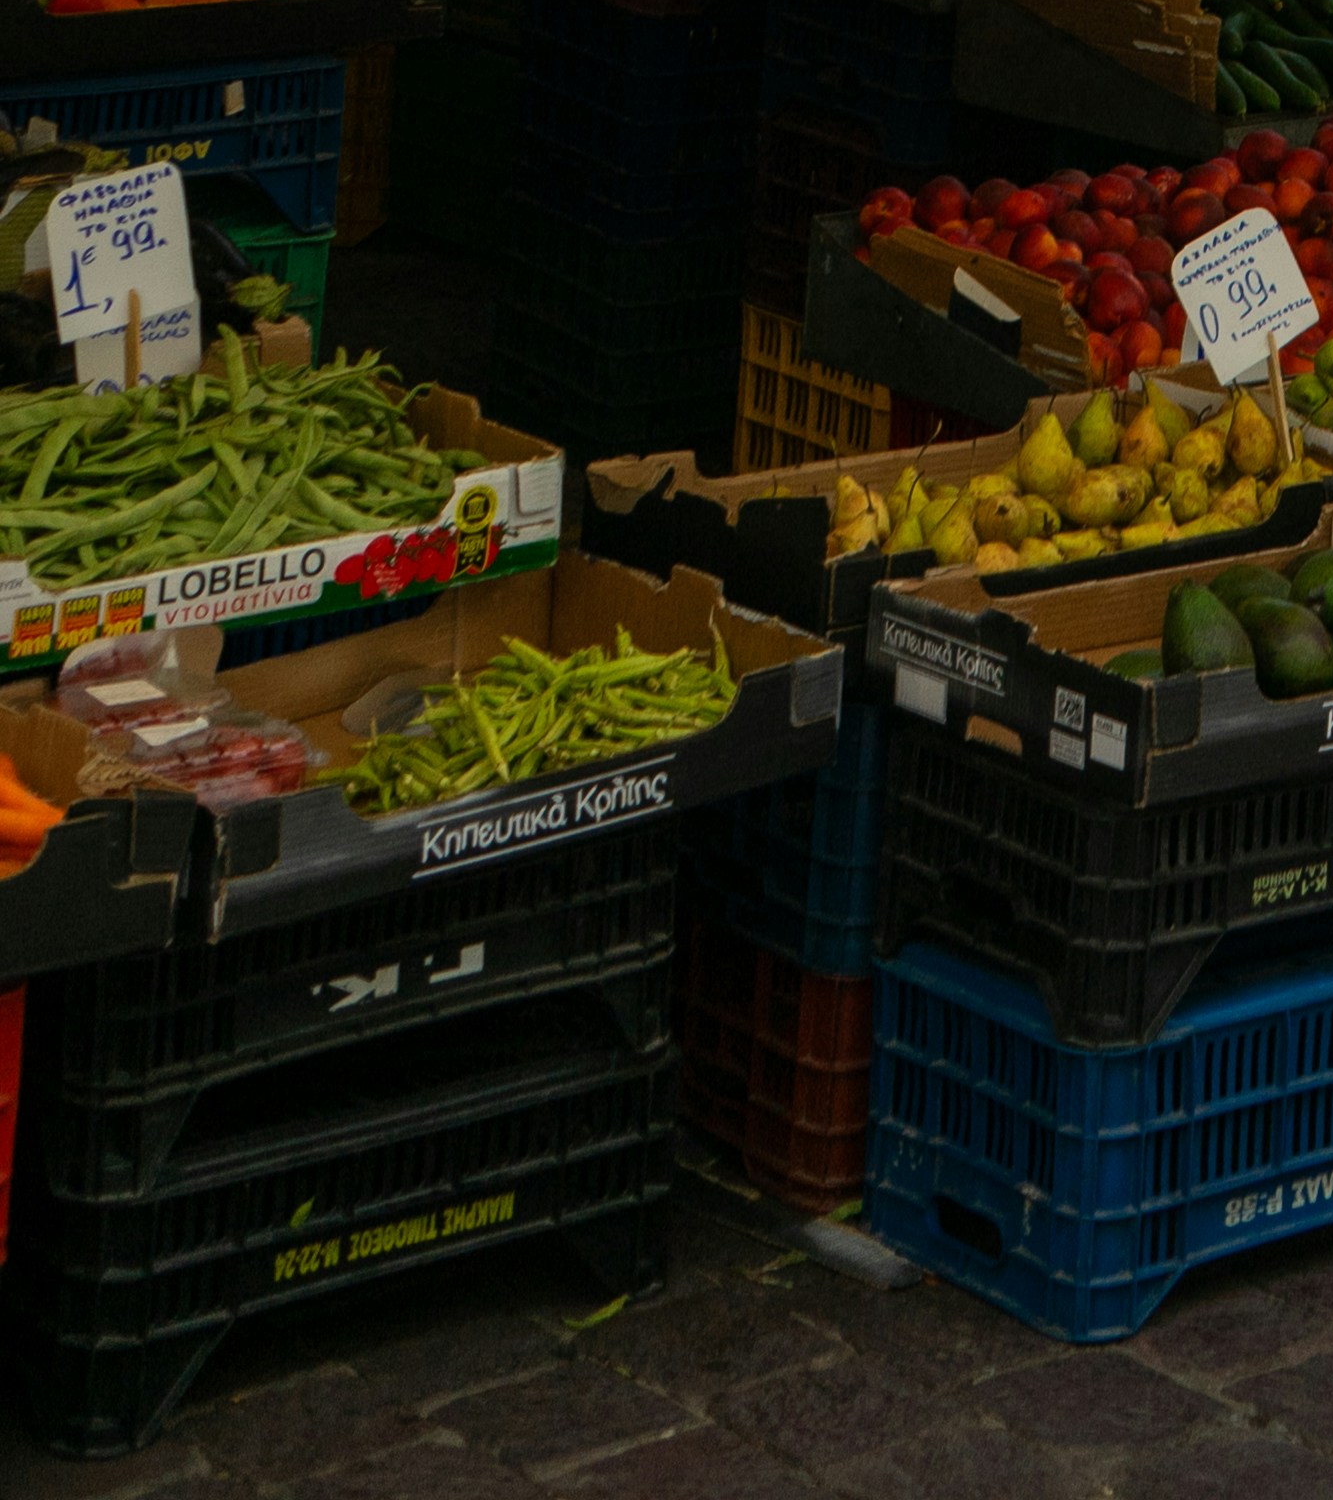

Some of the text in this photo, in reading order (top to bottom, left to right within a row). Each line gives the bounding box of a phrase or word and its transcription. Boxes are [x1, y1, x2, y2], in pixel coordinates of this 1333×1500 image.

[158, 548, 325, 605] LOBELLO
[165, 583, 312, 626] ντοματίνια
[422, 772, 668, 864] Κηπευτικά Κρήτης
[347, 1212, 437, 1262] ΤΙΜΟΘΕΟΣ
[441, 1190, 516, 1238] ΜΑΚΡΗΣ
